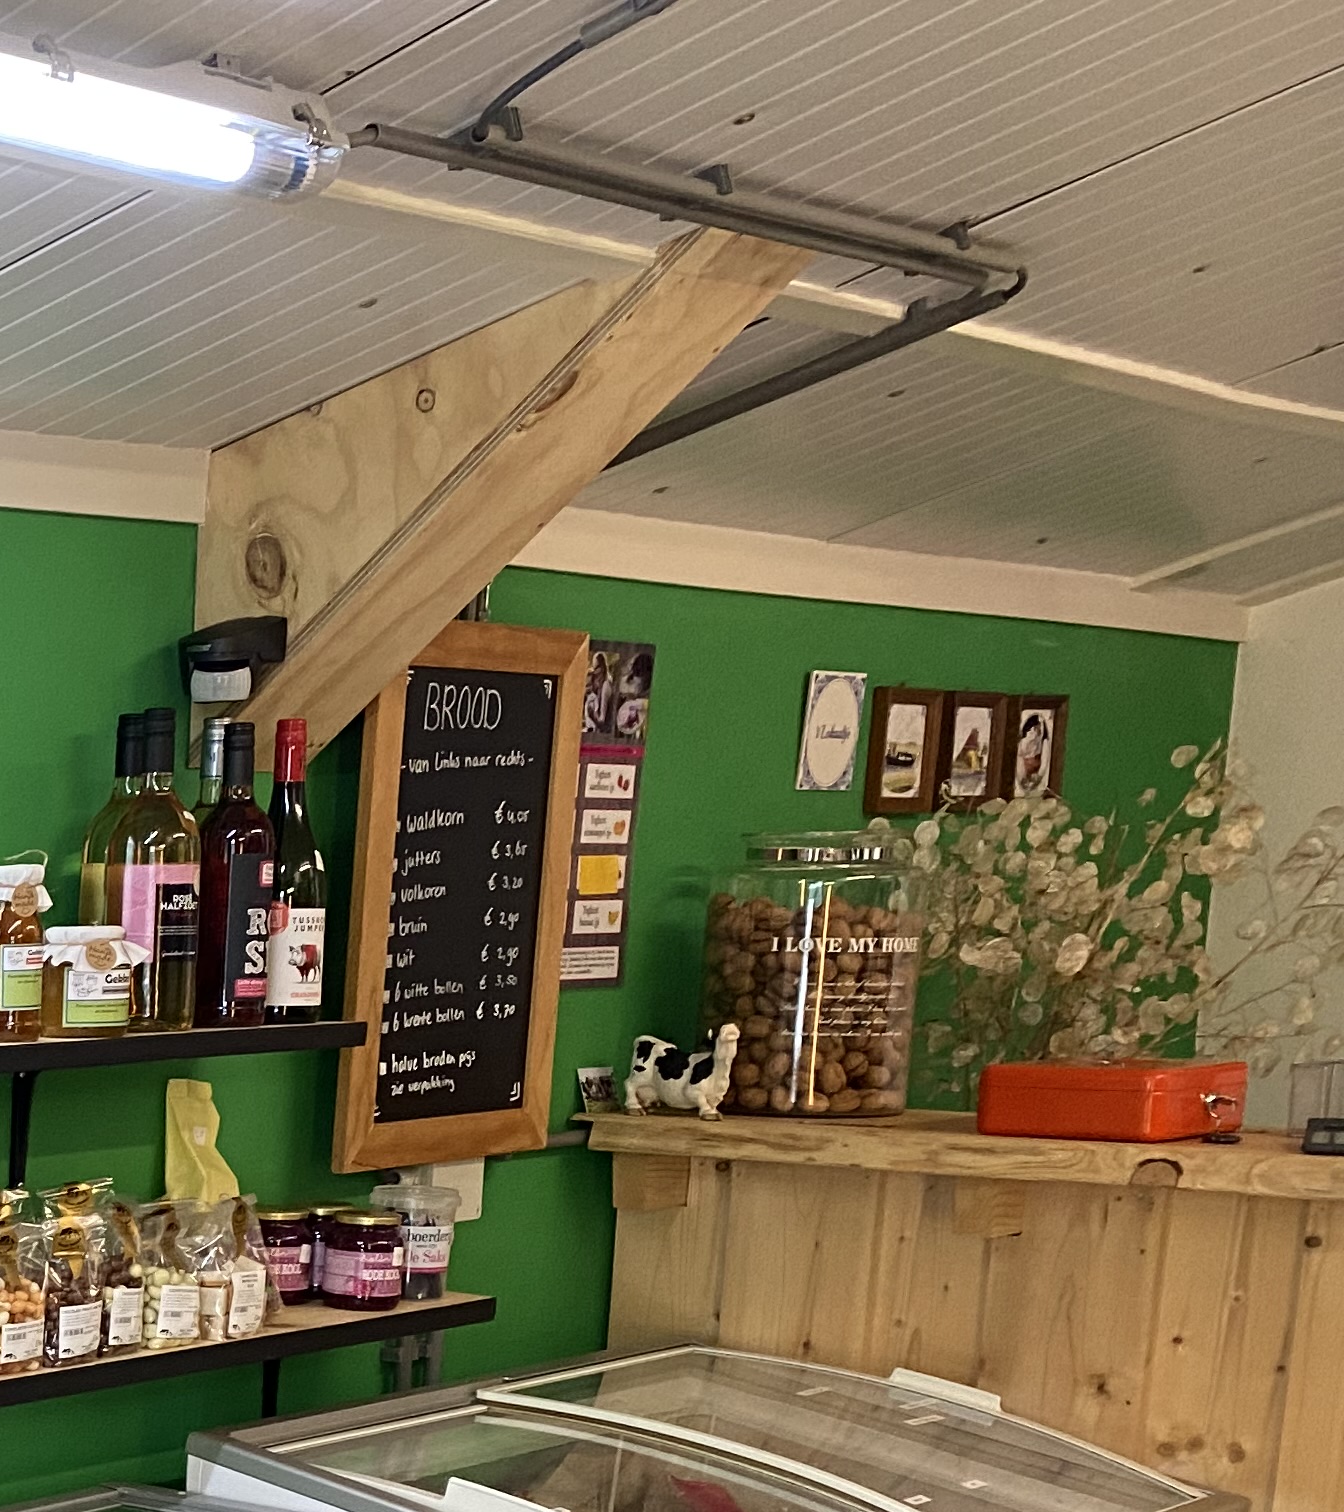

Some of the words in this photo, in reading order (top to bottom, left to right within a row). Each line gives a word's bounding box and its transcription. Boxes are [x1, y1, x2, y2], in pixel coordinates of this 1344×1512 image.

[423, 682, 503, 732] BROOD
[434, 750, 461, 772] links
[464, 754, 489, 768] naar
[406, 809, 465, 833] Waldkorn
[401, 849, 441, 877] jutters
[400, 884, 447, 904] volkoren
[398, 916, 428, 935] bruin
[770, 936, 780, 952] I
[784, 936, 843, 953] LOVE
[847, 937, 879, 953] MY
[881, 936, 920, 953] HOME
[396, 947, 416, 967] wit
[404, 980, 429, 998] witte
[433, 978, 464, 996] bollen
[435, 1006, 466, 1023] bollen
[391, 1053, 419, 1074] halve
